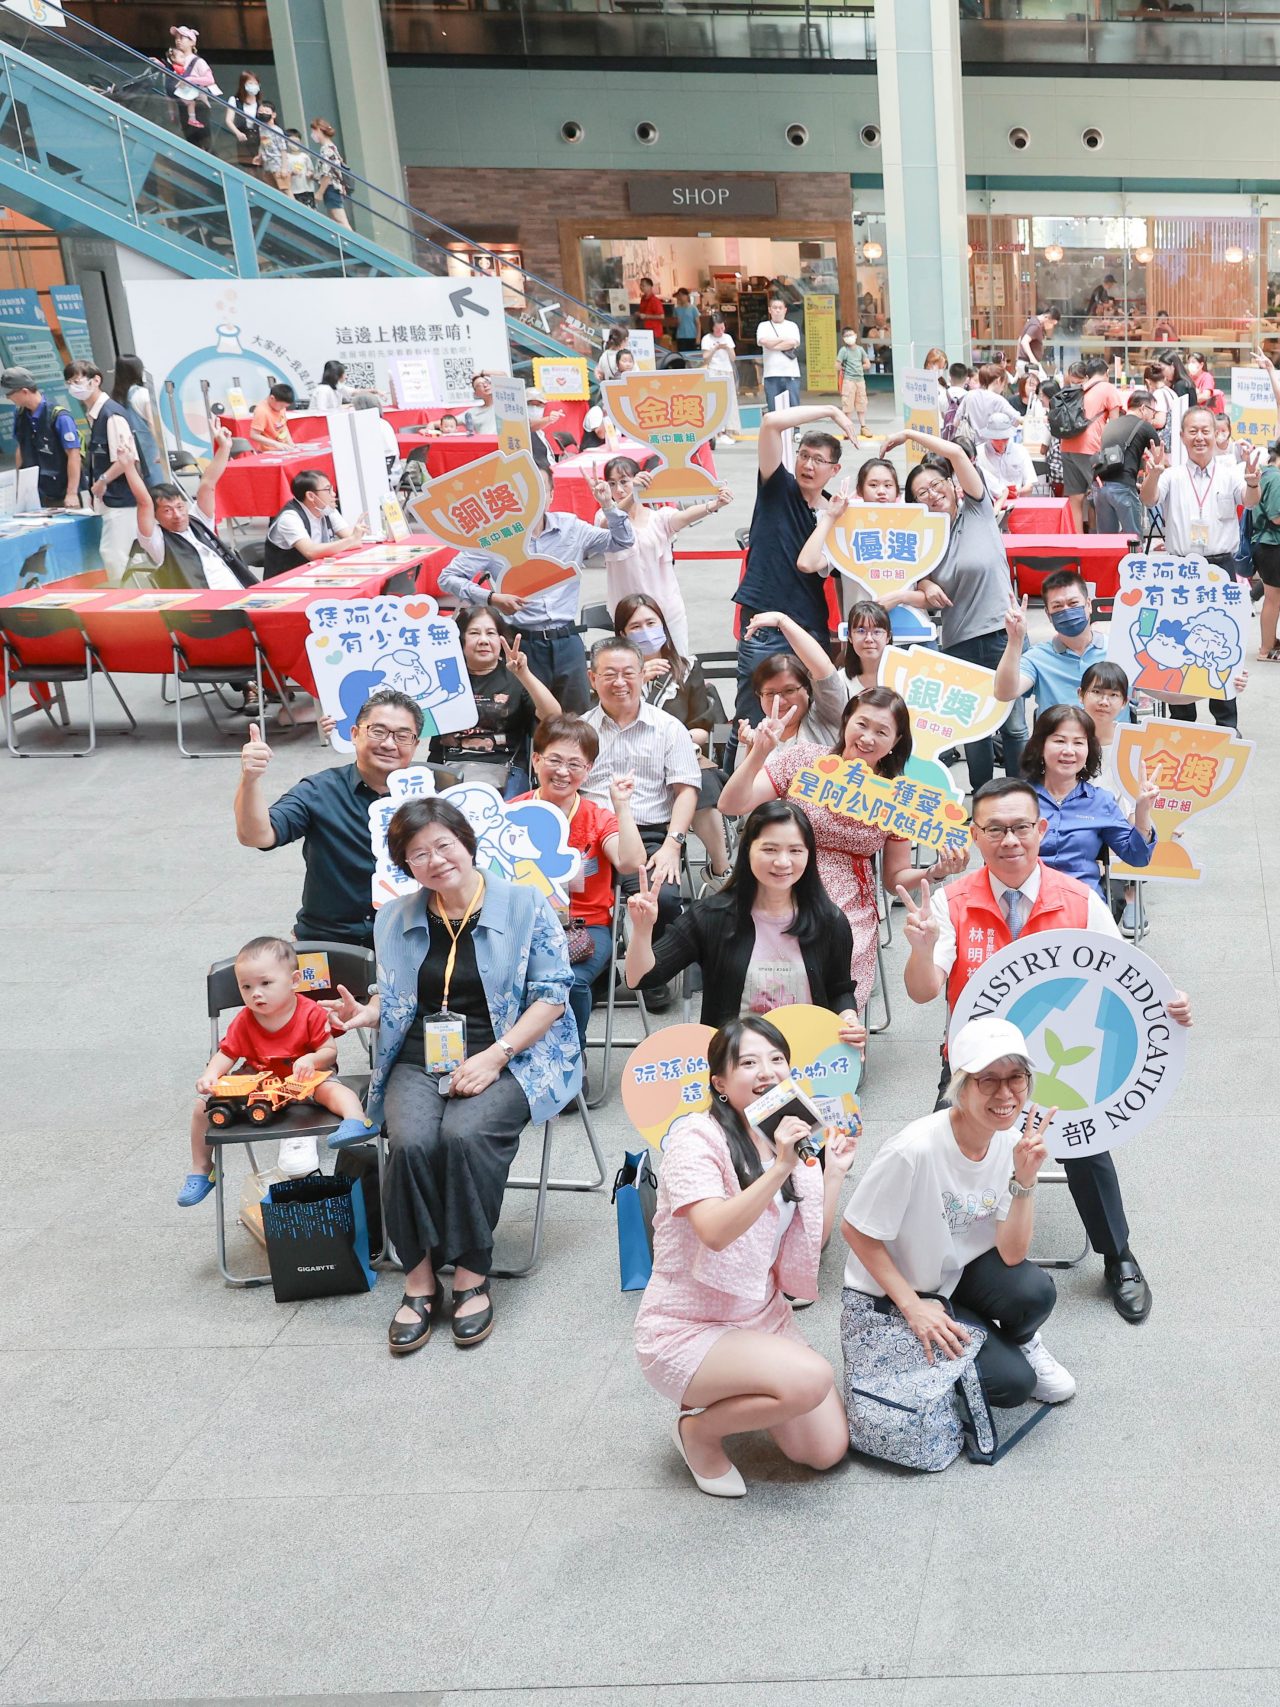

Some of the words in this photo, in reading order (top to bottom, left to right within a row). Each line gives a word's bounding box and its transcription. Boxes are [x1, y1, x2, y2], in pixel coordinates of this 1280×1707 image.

[672, 188, 730, 205] SHOP
[336, 324, 471, 344] 這邊上樓驗票唷!
[634, 394, 705, 430] 金獎
[650, 433, 696, 445] 高中職組
[450, 483, 524, 536] 銅獎
[479, 522, 525, 548] 高中職組
[852, 530, 918, 562] 優選
[870, 569, 905, 580] 國中組
[1144, 585, 1242, 606] 有古錐無
[339, 623, 451, 653] 有少年無
[906, 677, 978, 725] 銀獎
[915, 718, 953, 738] 國中組
[1143, 750, 1220, 798] 金獎
[846, 762, 943, 817] 有一種愛
[796, 771, 968, 851] 是阿公阿媽的愛
[1154, 797, 1192, 812] 國中組
[968, 945, 1062, 1022] NISTRY
[1073, 945, 1116, 972] OF
[1104, 963, 1170, 1130] EDUCATION
[297, 1264, 336, 1272] GIGABYTE
